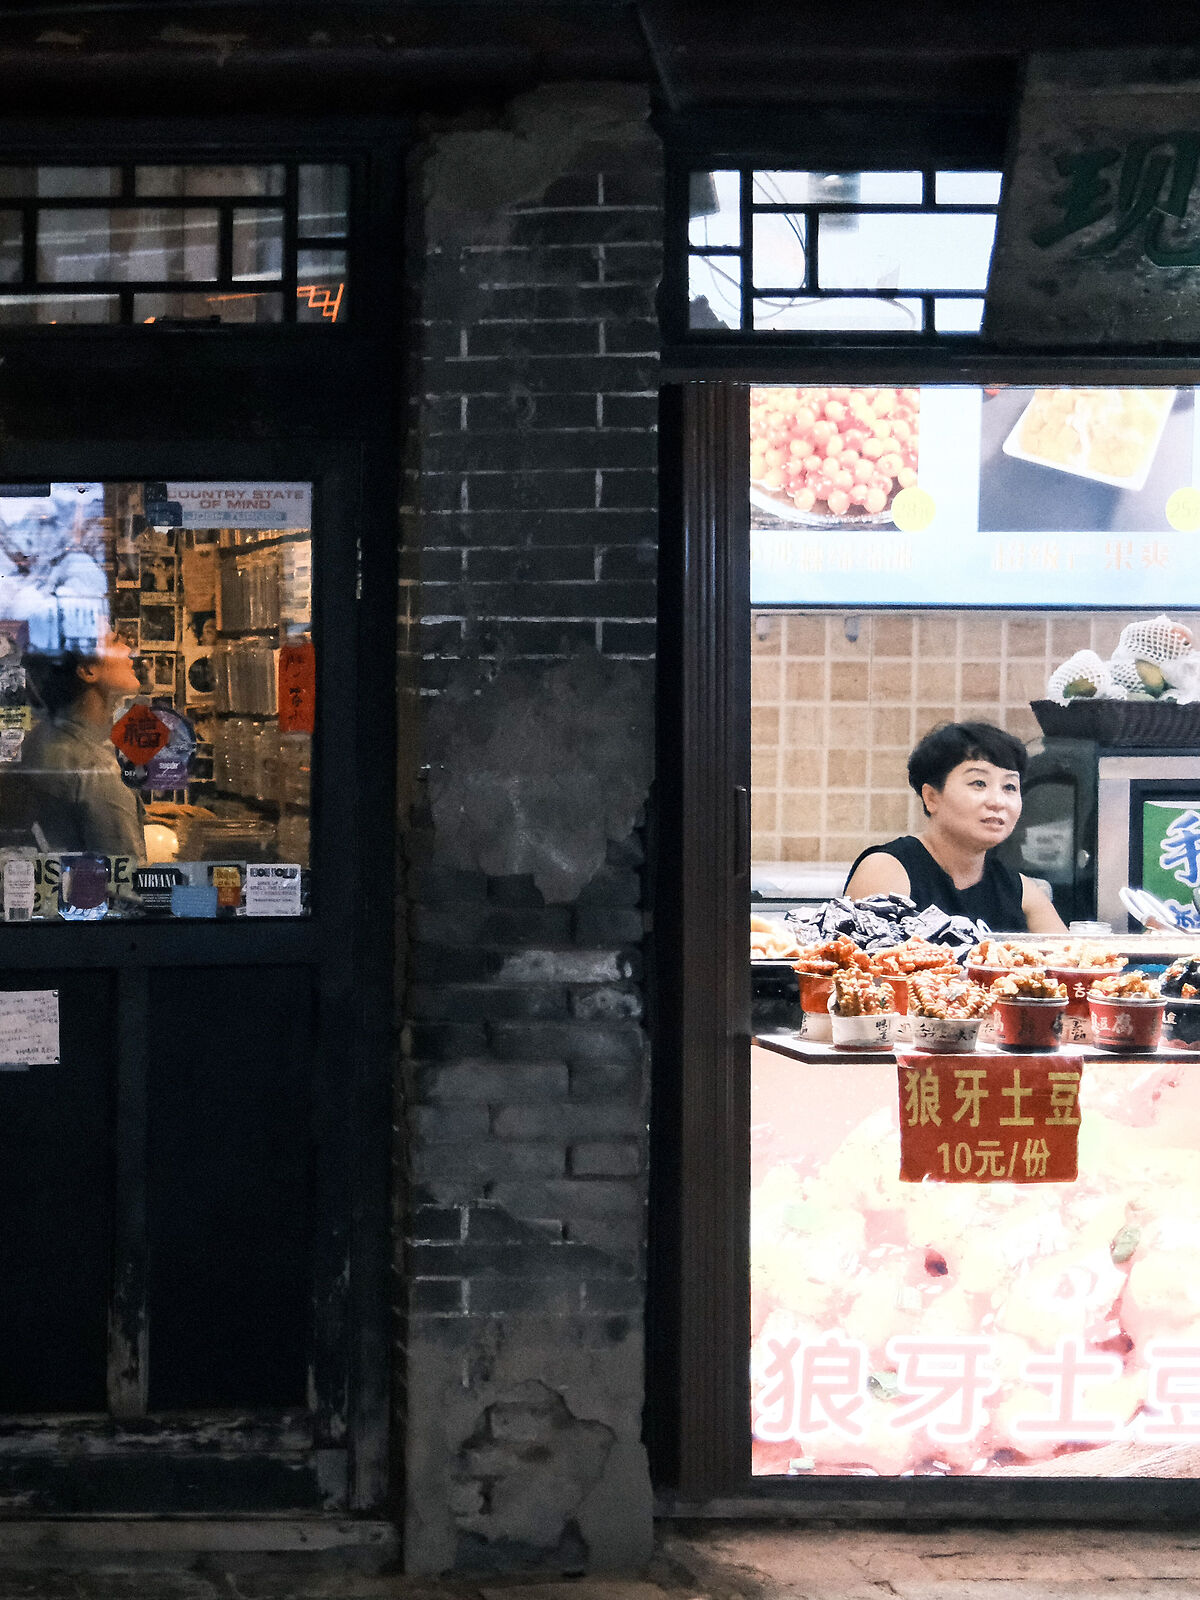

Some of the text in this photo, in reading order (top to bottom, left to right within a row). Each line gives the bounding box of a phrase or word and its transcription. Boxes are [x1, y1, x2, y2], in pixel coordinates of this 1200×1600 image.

[168, 490, 304, 499] COUNTRY STATE
[200, 500, 271, 509] OF MIND
[139, 874, 176, 887] NIRVANA
[904, 1068, 1081, 1128] 狼牙土豆
[937, 1138, 1051, 1177] 10元/份
